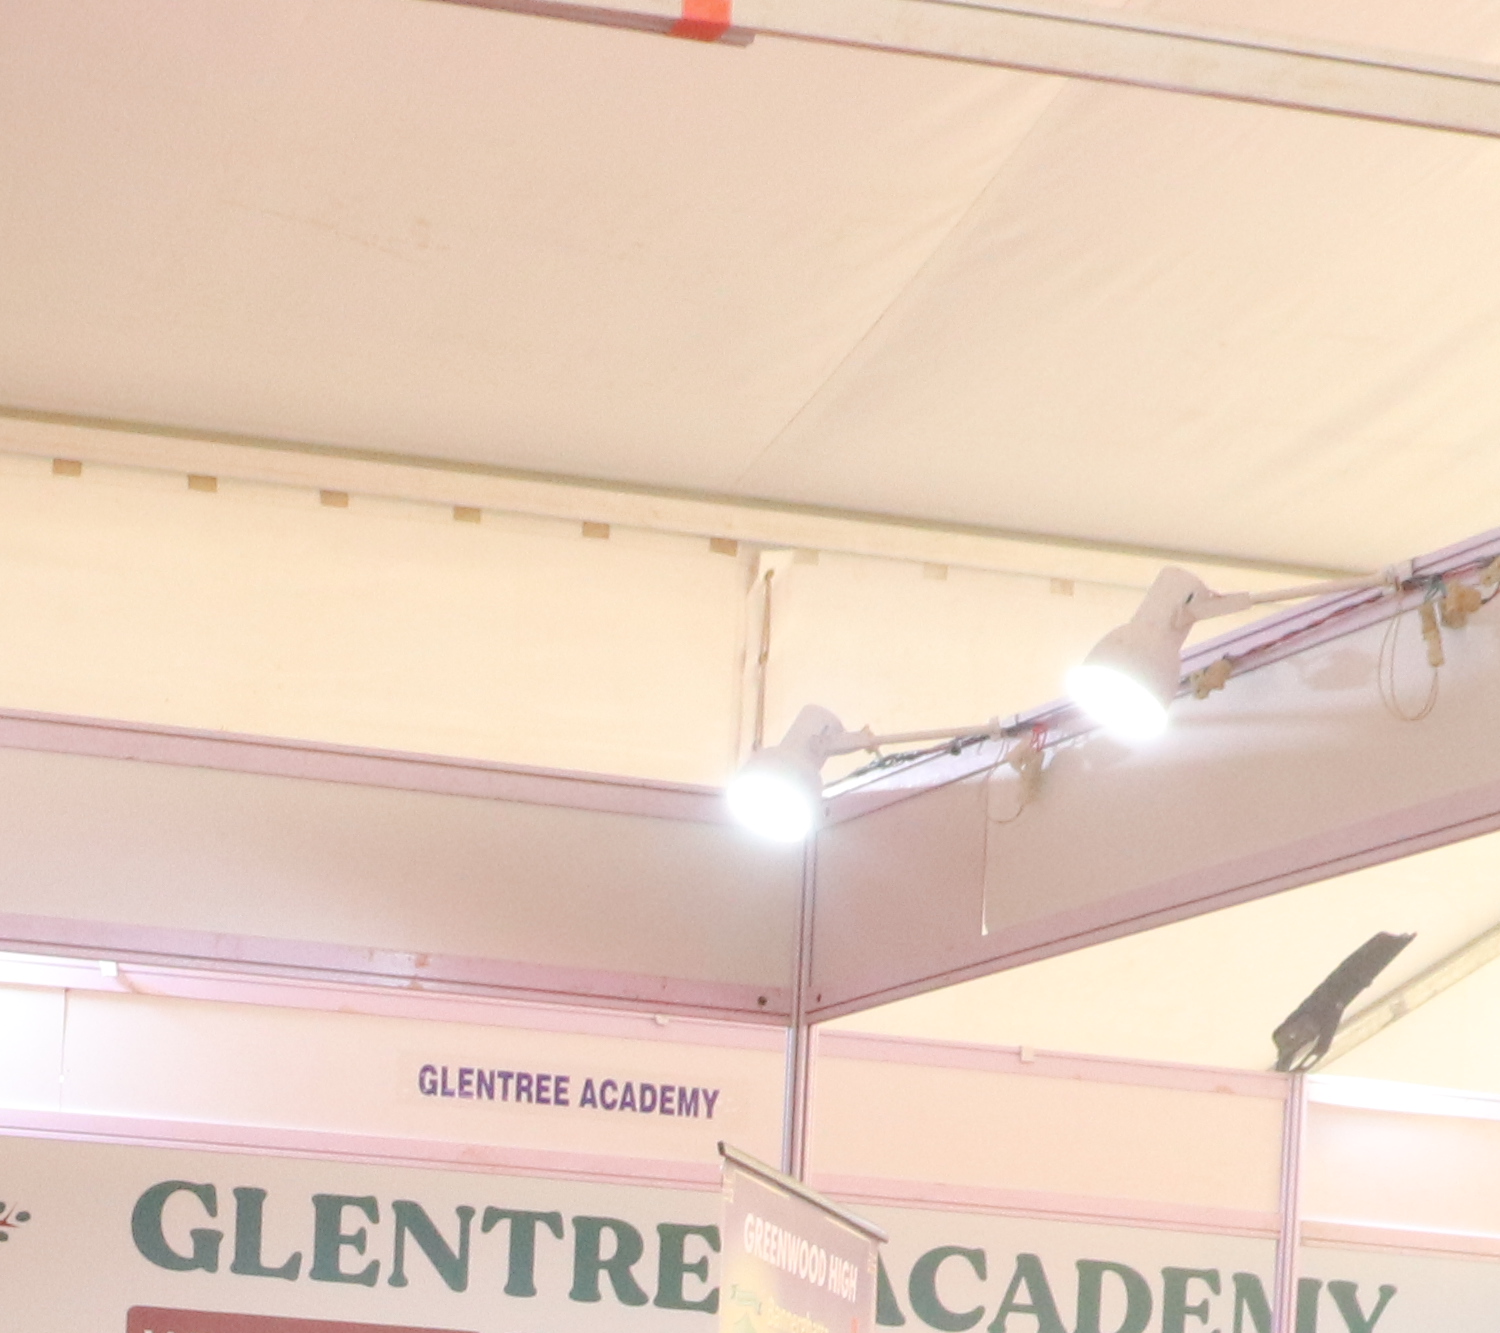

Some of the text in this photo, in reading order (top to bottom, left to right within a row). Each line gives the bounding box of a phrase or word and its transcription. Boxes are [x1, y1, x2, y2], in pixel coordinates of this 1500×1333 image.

[418, 1063, 720, 1120] GLENTREE ACADEMY
[130, 1179, 721, 1315] GLENTRE
[743, 1212, 859, 1303] GREENWOOD HIGH
